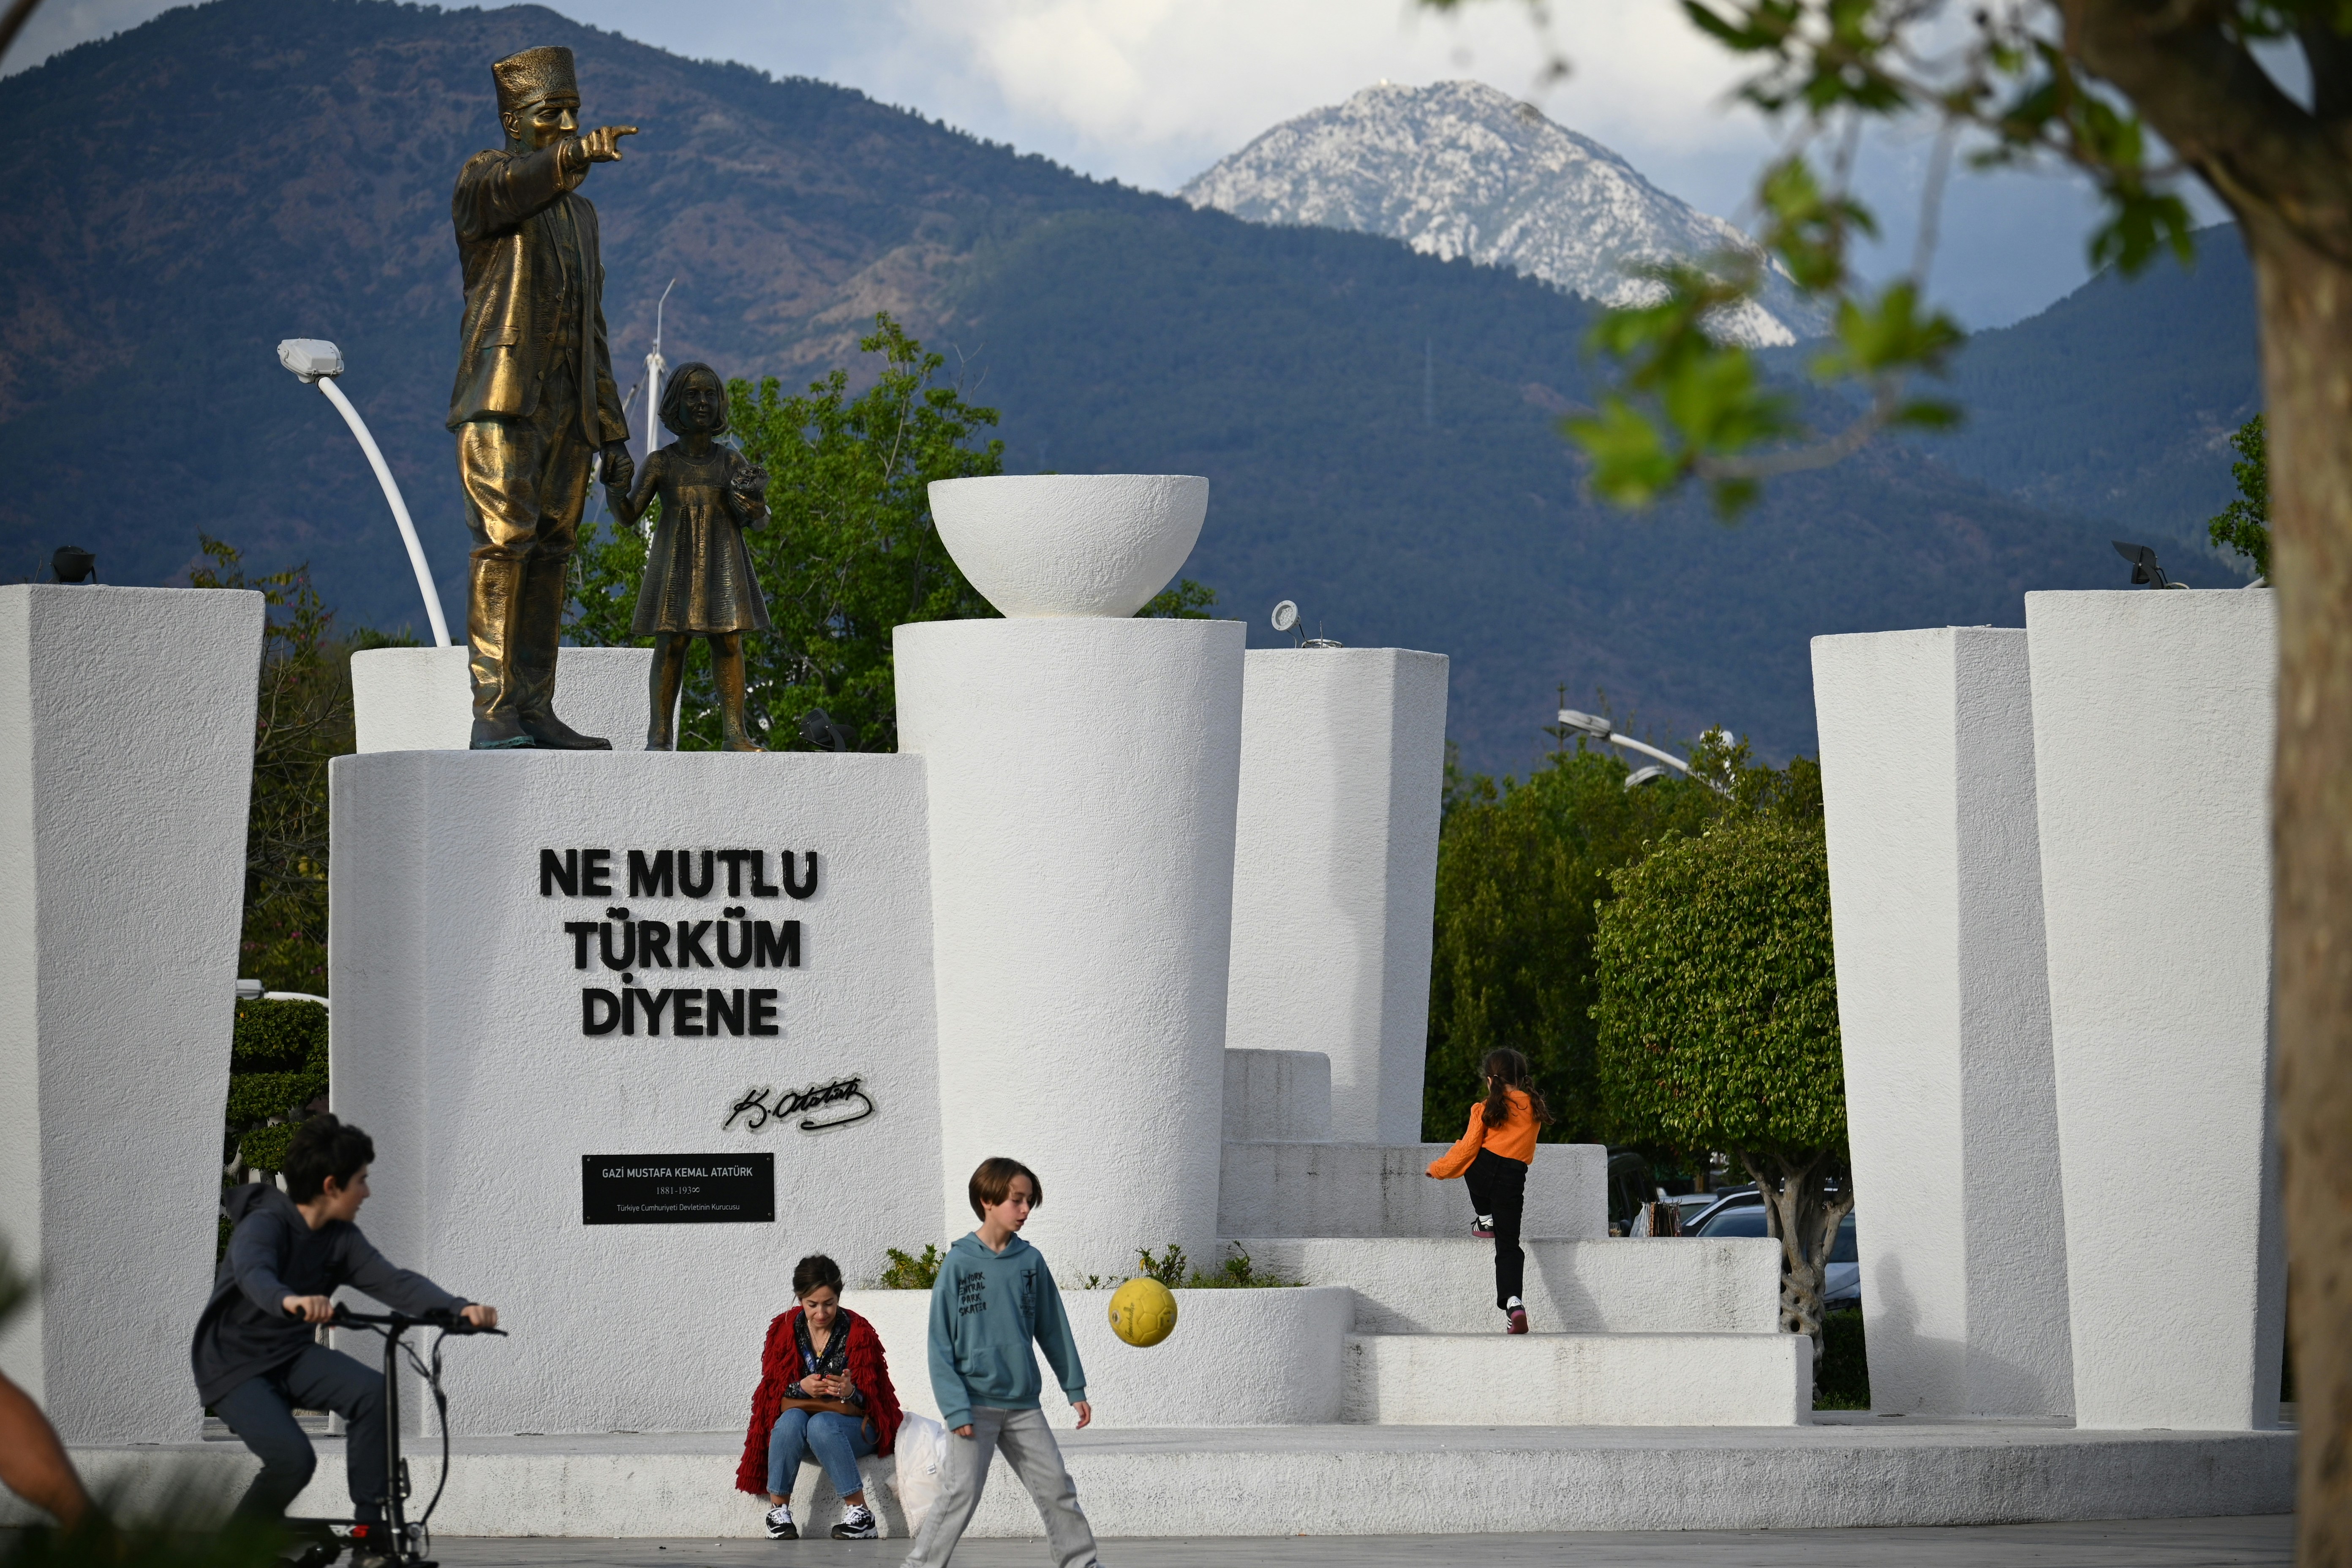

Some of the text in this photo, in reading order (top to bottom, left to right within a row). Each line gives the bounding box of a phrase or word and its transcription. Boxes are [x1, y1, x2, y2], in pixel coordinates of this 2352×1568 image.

[540, 849, 817, 899] NE MUTLU
[564, 906, 800, 970] TÜRKÜM
[582, 972, 779, 1035] DİYENE
[602, 1165, 753, 1178] GAZİ MUSTAFA KEMAL ATATÜRK
[617, 1204, 640, 1213] Türkiye
[641, 1204, 678, 1212] Cumhuriyeti
[967, 1271, 985, 1284] YORK
[959, 1282, 985, 1296] ENTRAL
[961, 1293, 982, 1305] PARK
